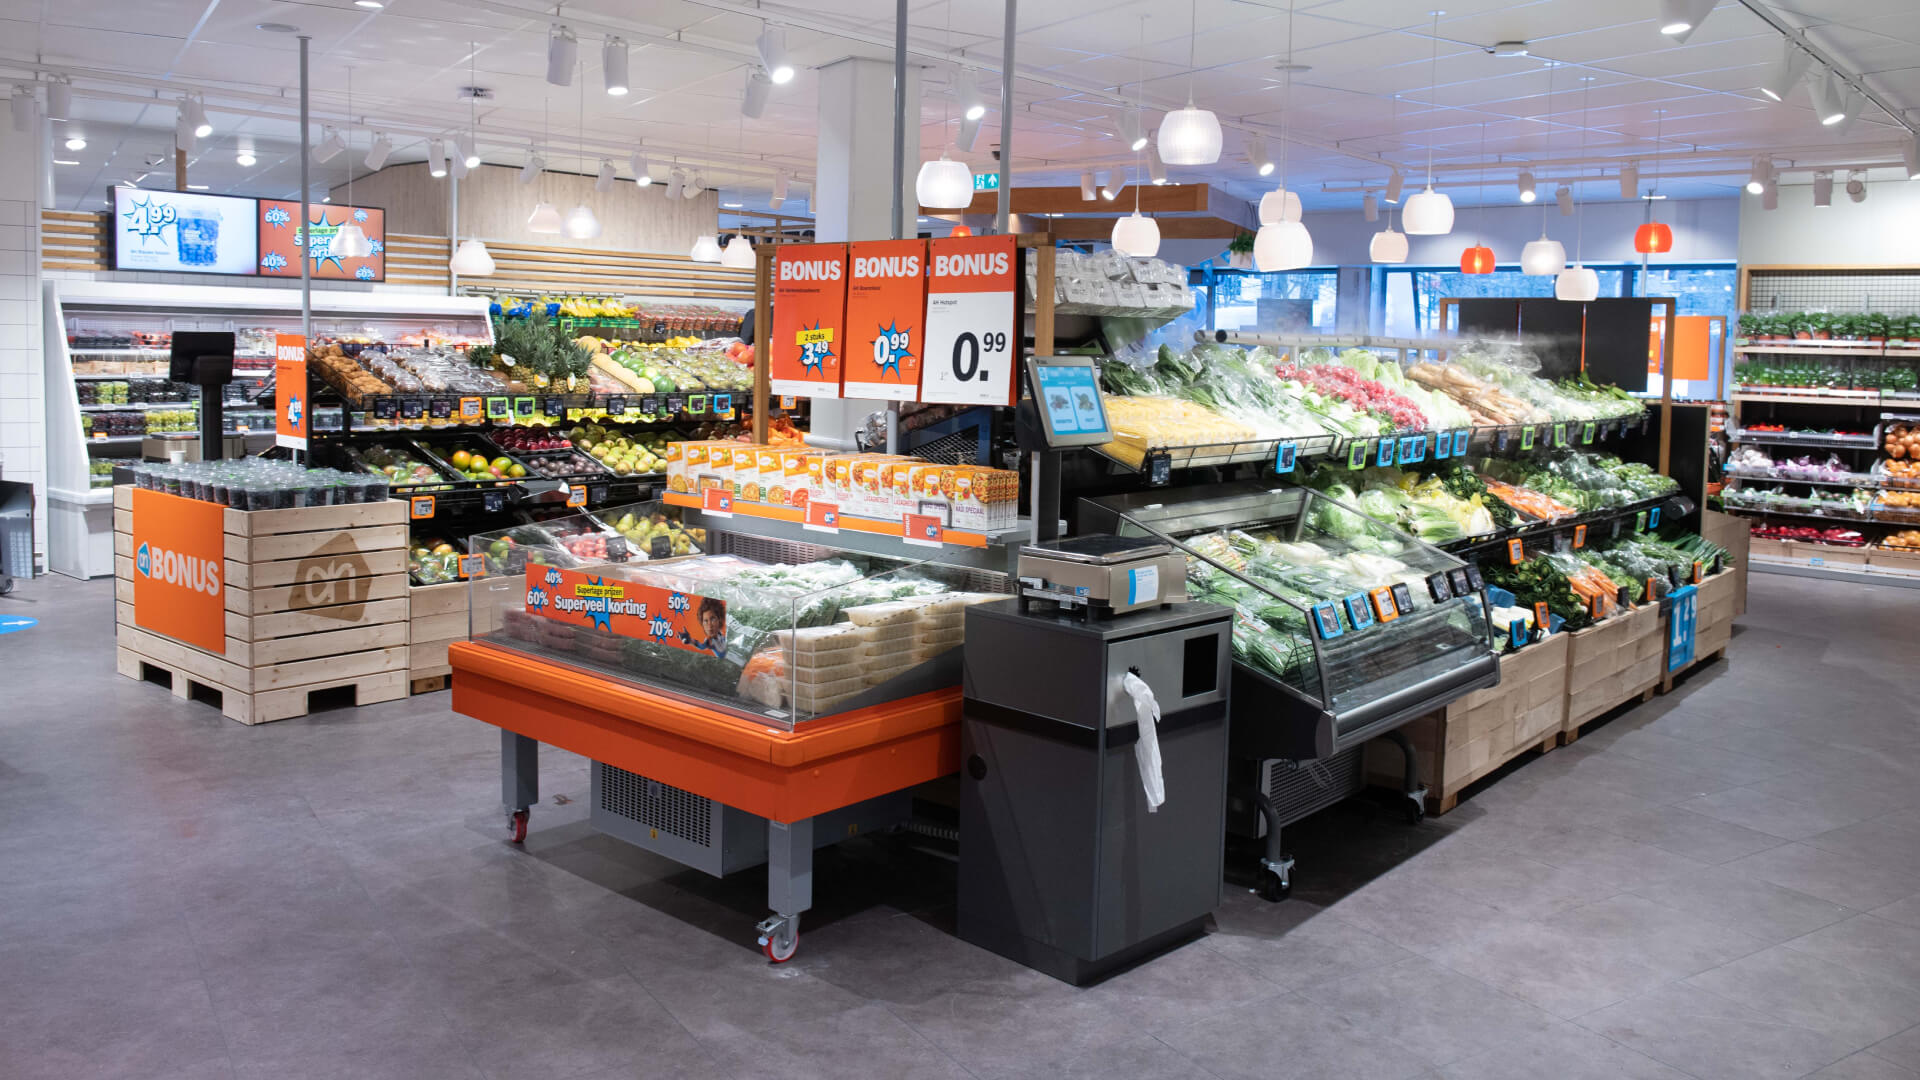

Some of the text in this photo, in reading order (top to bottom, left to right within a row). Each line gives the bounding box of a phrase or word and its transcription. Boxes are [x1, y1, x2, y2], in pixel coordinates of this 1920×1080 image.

[128, 206, 176, 235] 4.99
[265, 211, 290, 222] 60%
[261, 256, 288, 267] 40%
[780, 260, 841, 281] BONUS
[854, 255, 919, 278] BONUS
[935, 252, 1009, 277] BONUS
[810, 333, 825, 341] stuks
[277, 345, 305, 362] BONUS
[802, 341, 829, 365] 3.49
[874, 332, 909, 365] 0.99
[952, 331, 1006, 382] 0.99
[151, 546, 220, 597] BONUS
[544, 571, 563, 584] 40%
[527, 590, 549, 606] 60%
[576, 586, 623, 598] Superlage prijzen
[554, 595, 647, 619] Superveel korting
[668, 596, 690, 611] 50%
[648, 620, 674, 637] 70%
